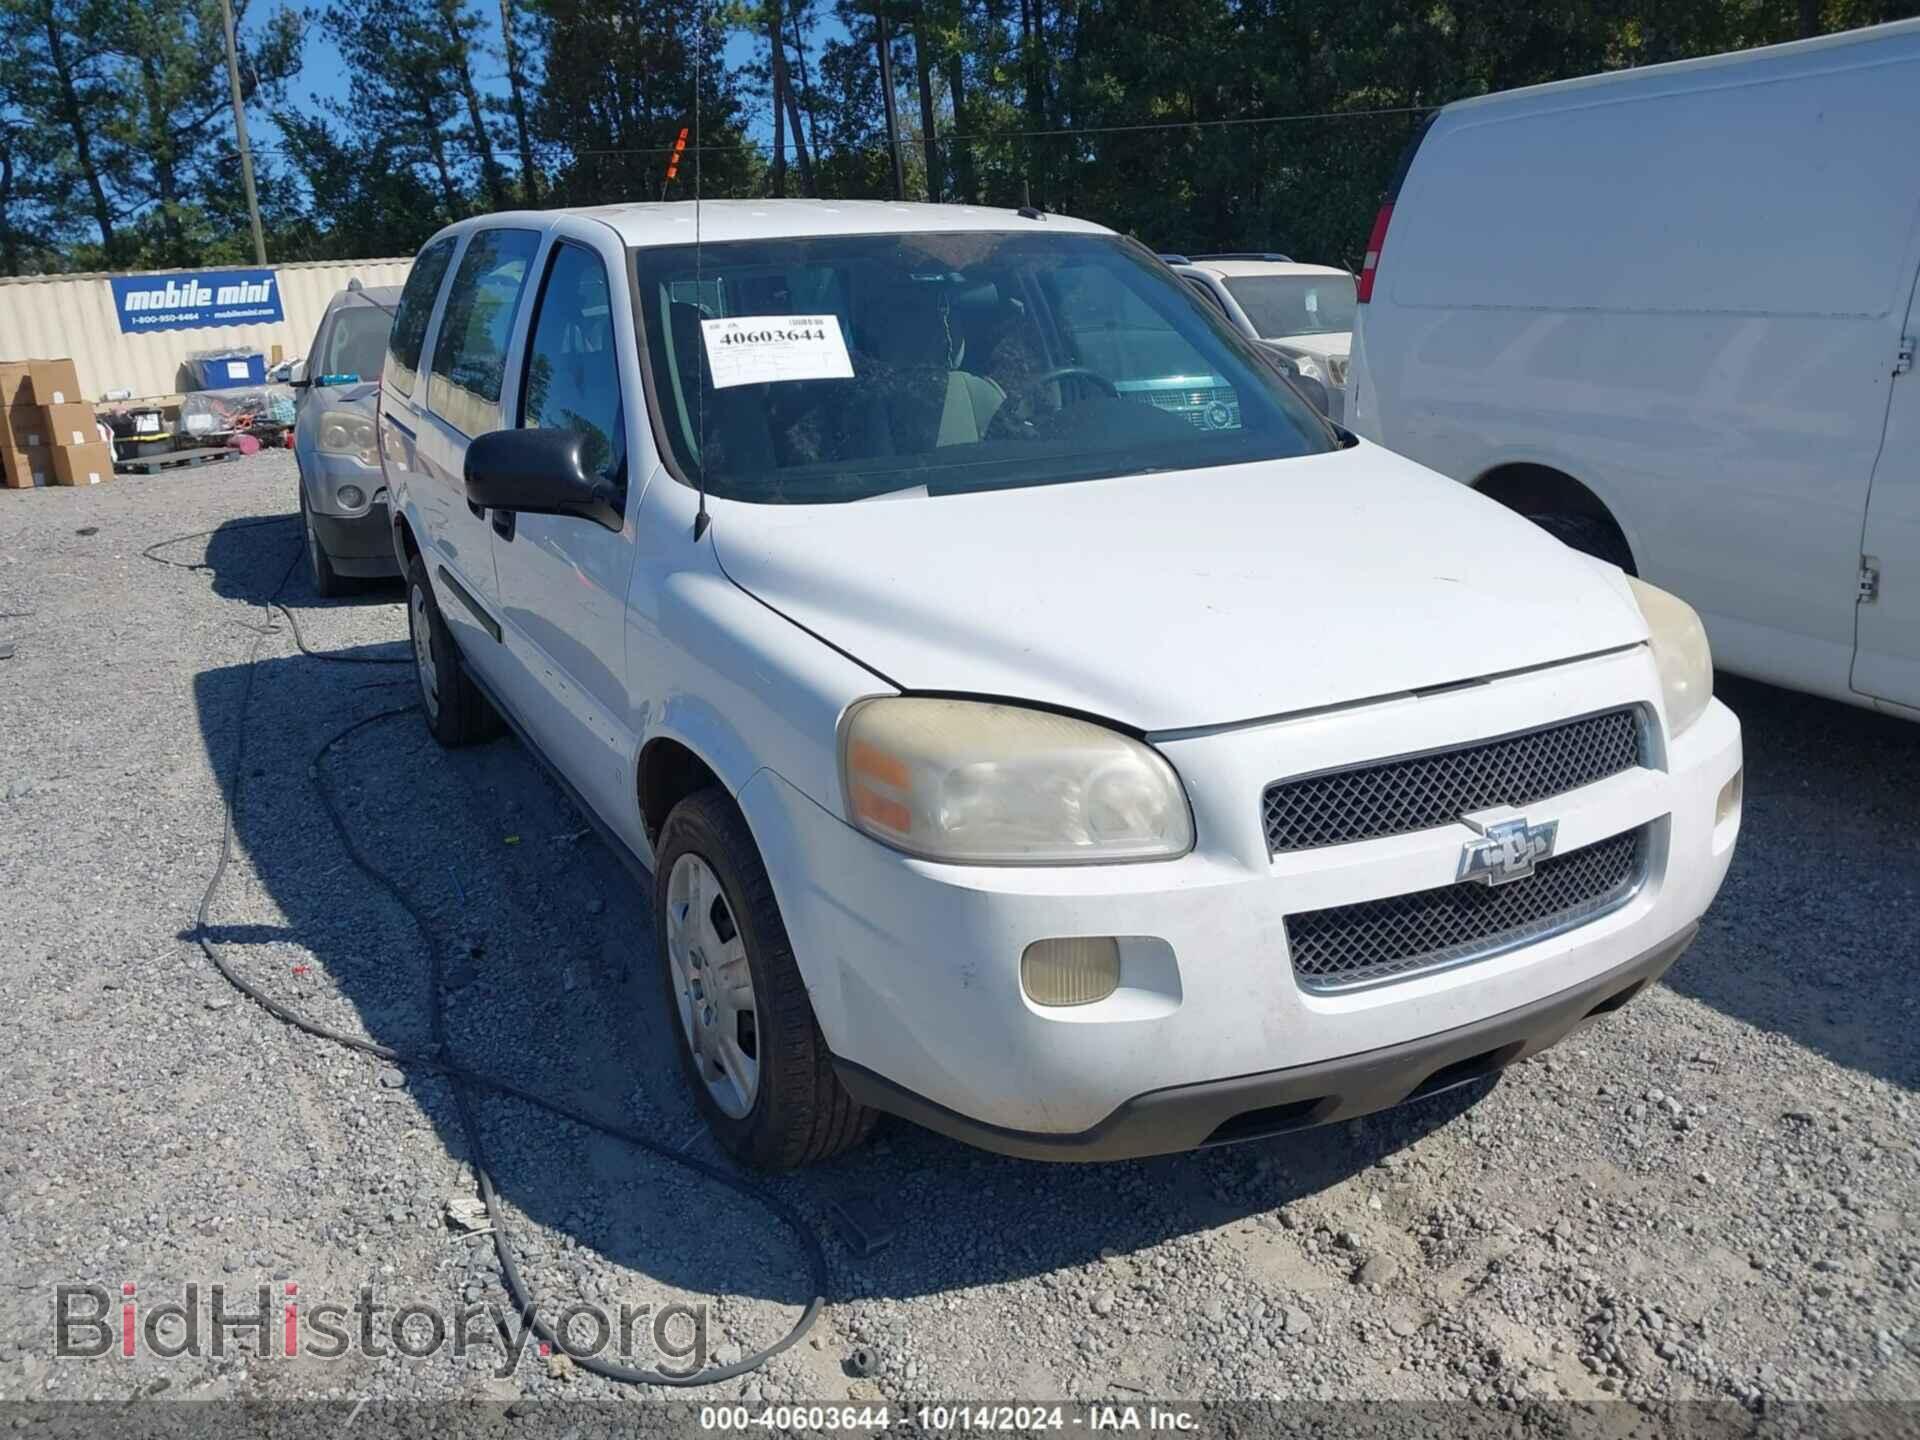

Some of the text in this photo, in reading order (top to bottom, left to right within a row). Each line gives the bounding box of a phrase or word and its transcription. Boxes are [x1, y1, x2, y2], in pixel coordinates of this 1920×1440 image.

[125, 279, 271, 312] mobile mini
[720, 329, 825, 345] 40603644
